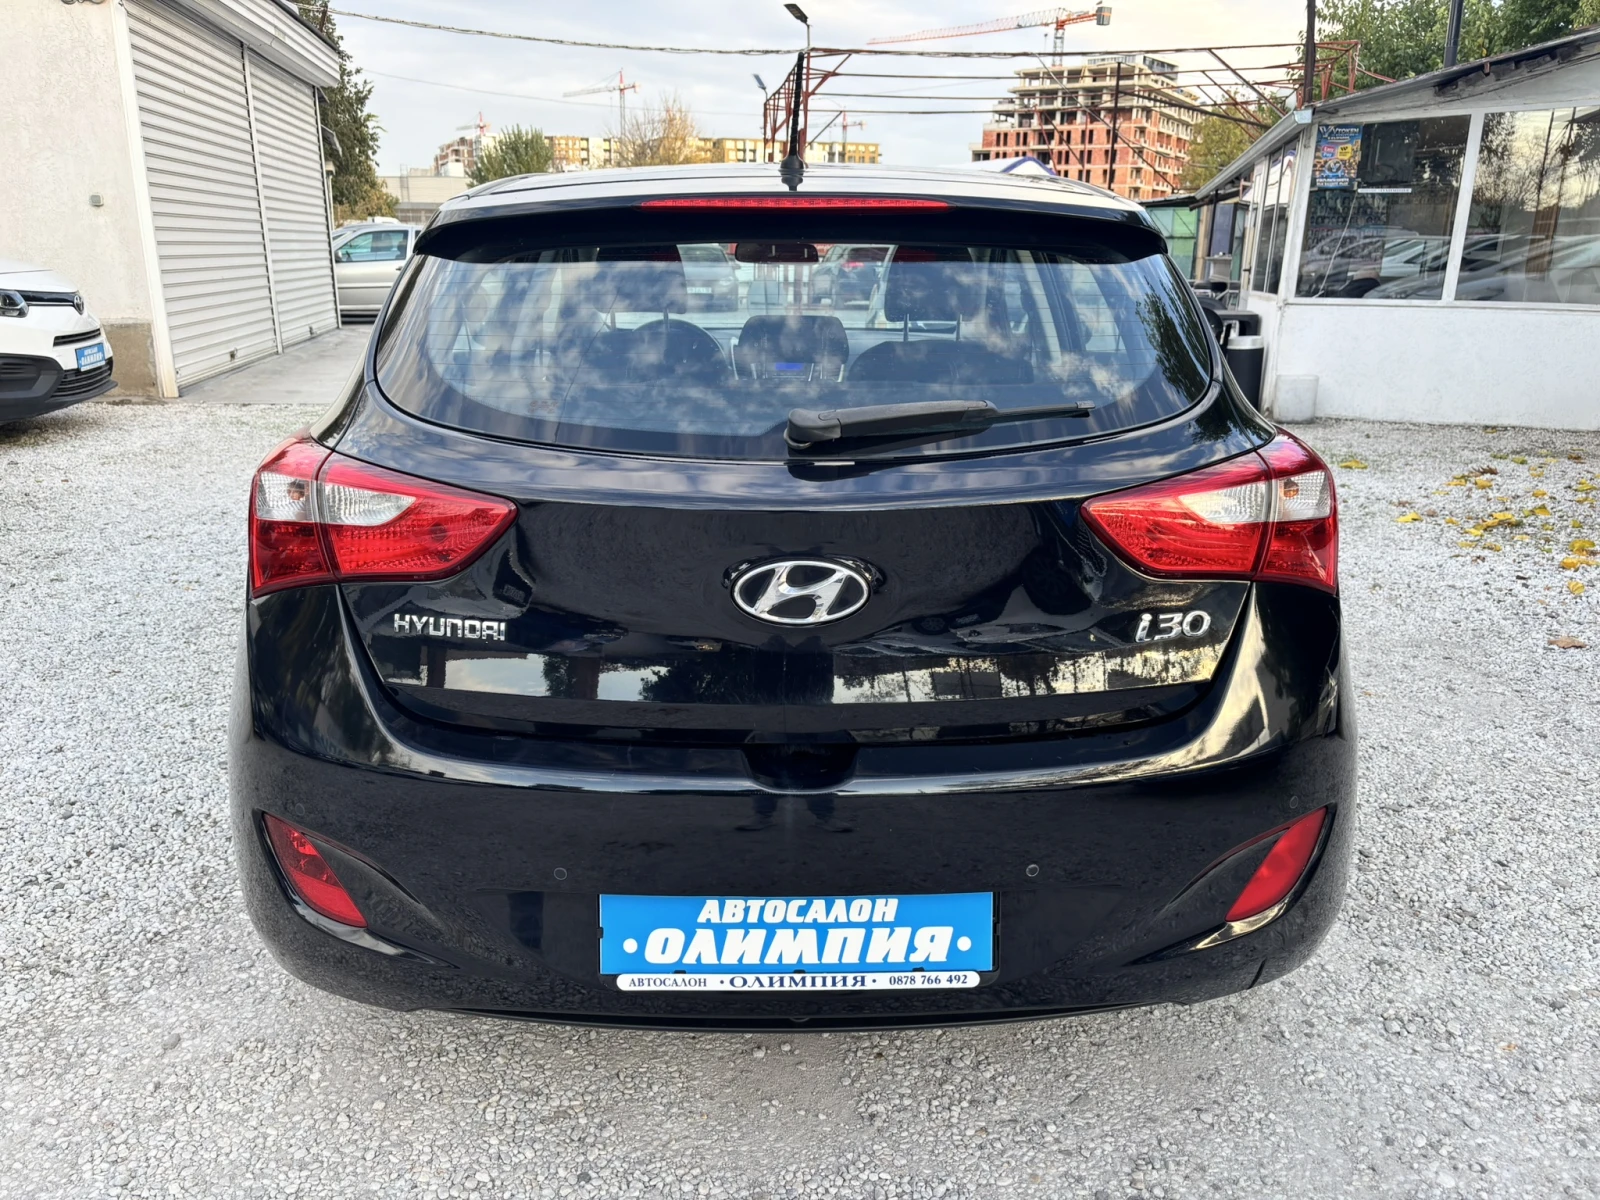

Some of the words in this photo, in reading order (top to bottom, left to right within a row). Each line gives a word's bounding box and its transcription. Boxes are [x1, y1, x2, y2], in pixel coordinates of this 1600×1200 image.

[393, 613, 506, 641] HYUNDAI
[1135, 610, 1211, 643] i30
[697, 898, 899, 924] АВТОСАЛОН
[643, 926, 954, 965] ОЛИМПИЯ
[628, 977, 707, 988] АВТОСАЛОН
[729, 975, 868, 989] ОЛИМПИЯ
[889, 975, 916, 986] 0878
[920, 974, 941, 985] 766
[946, 974, 968, 985] 492
